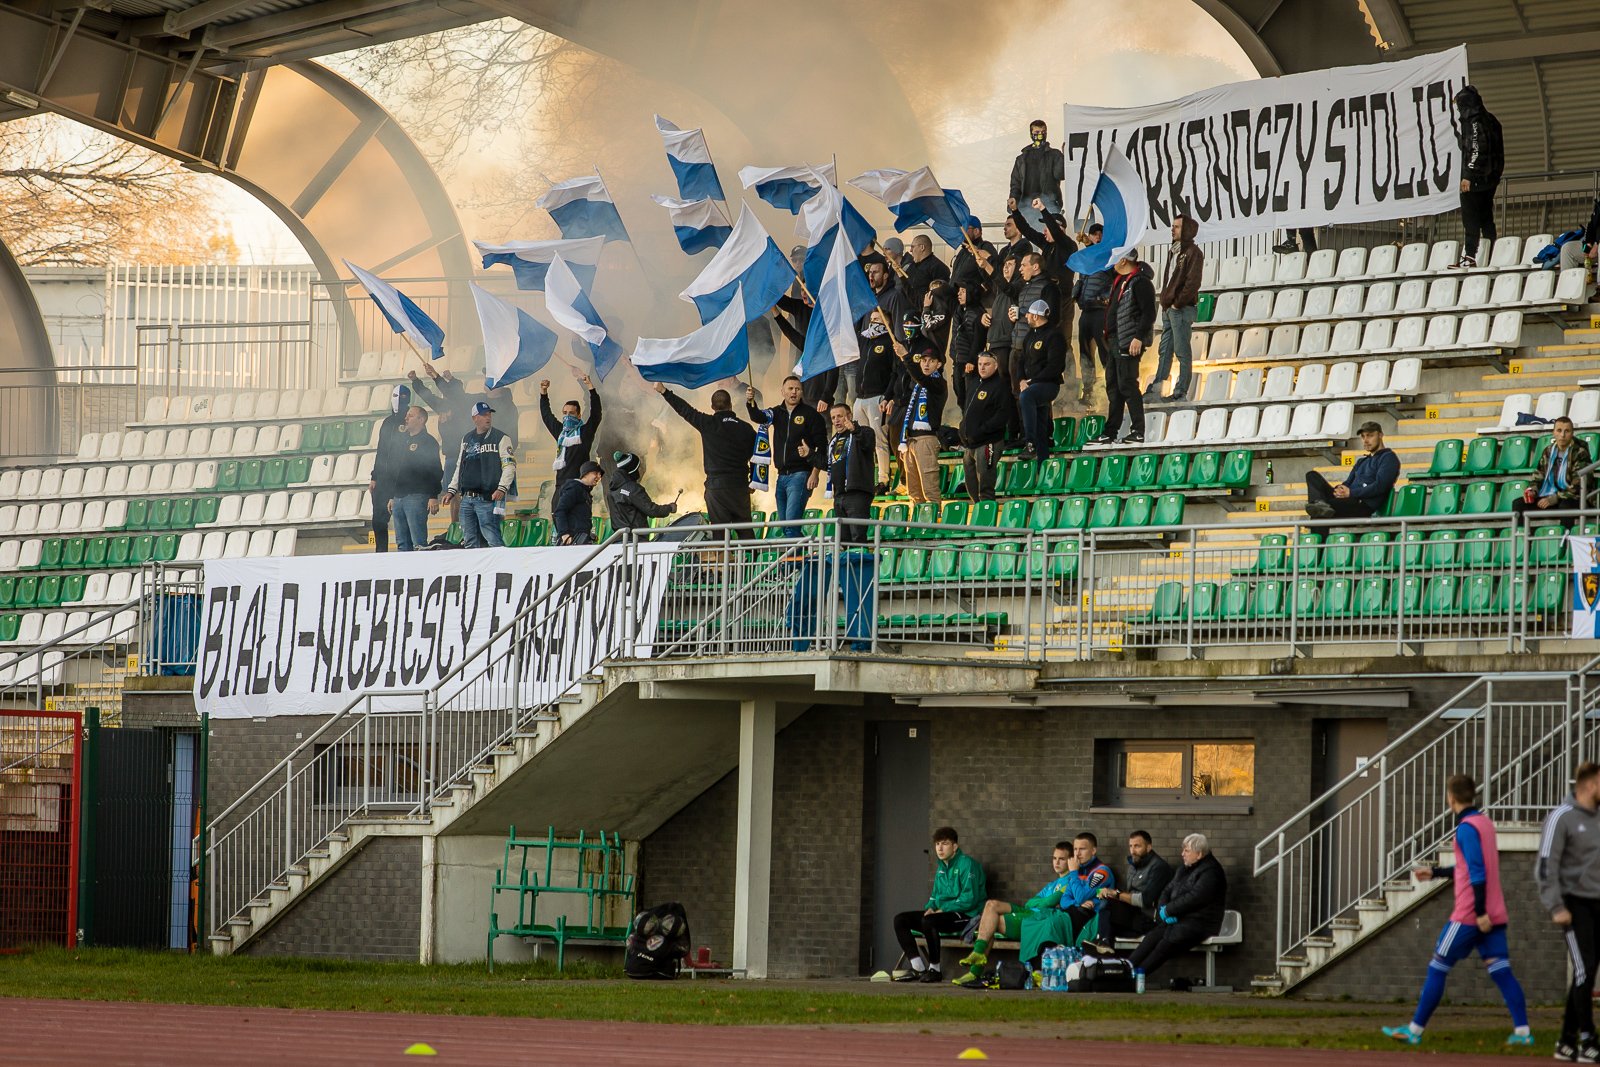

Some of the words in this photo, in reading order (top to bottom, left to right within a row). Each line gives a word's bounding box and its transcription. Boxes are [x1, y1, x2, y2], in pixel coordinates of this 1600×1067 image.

[1512, 366, 1520, 374] E7
[1429, 411, 1437, 419] E6
[1344, 457, 1353, 466] E5
[1259, 503, 1267, 512] E4
